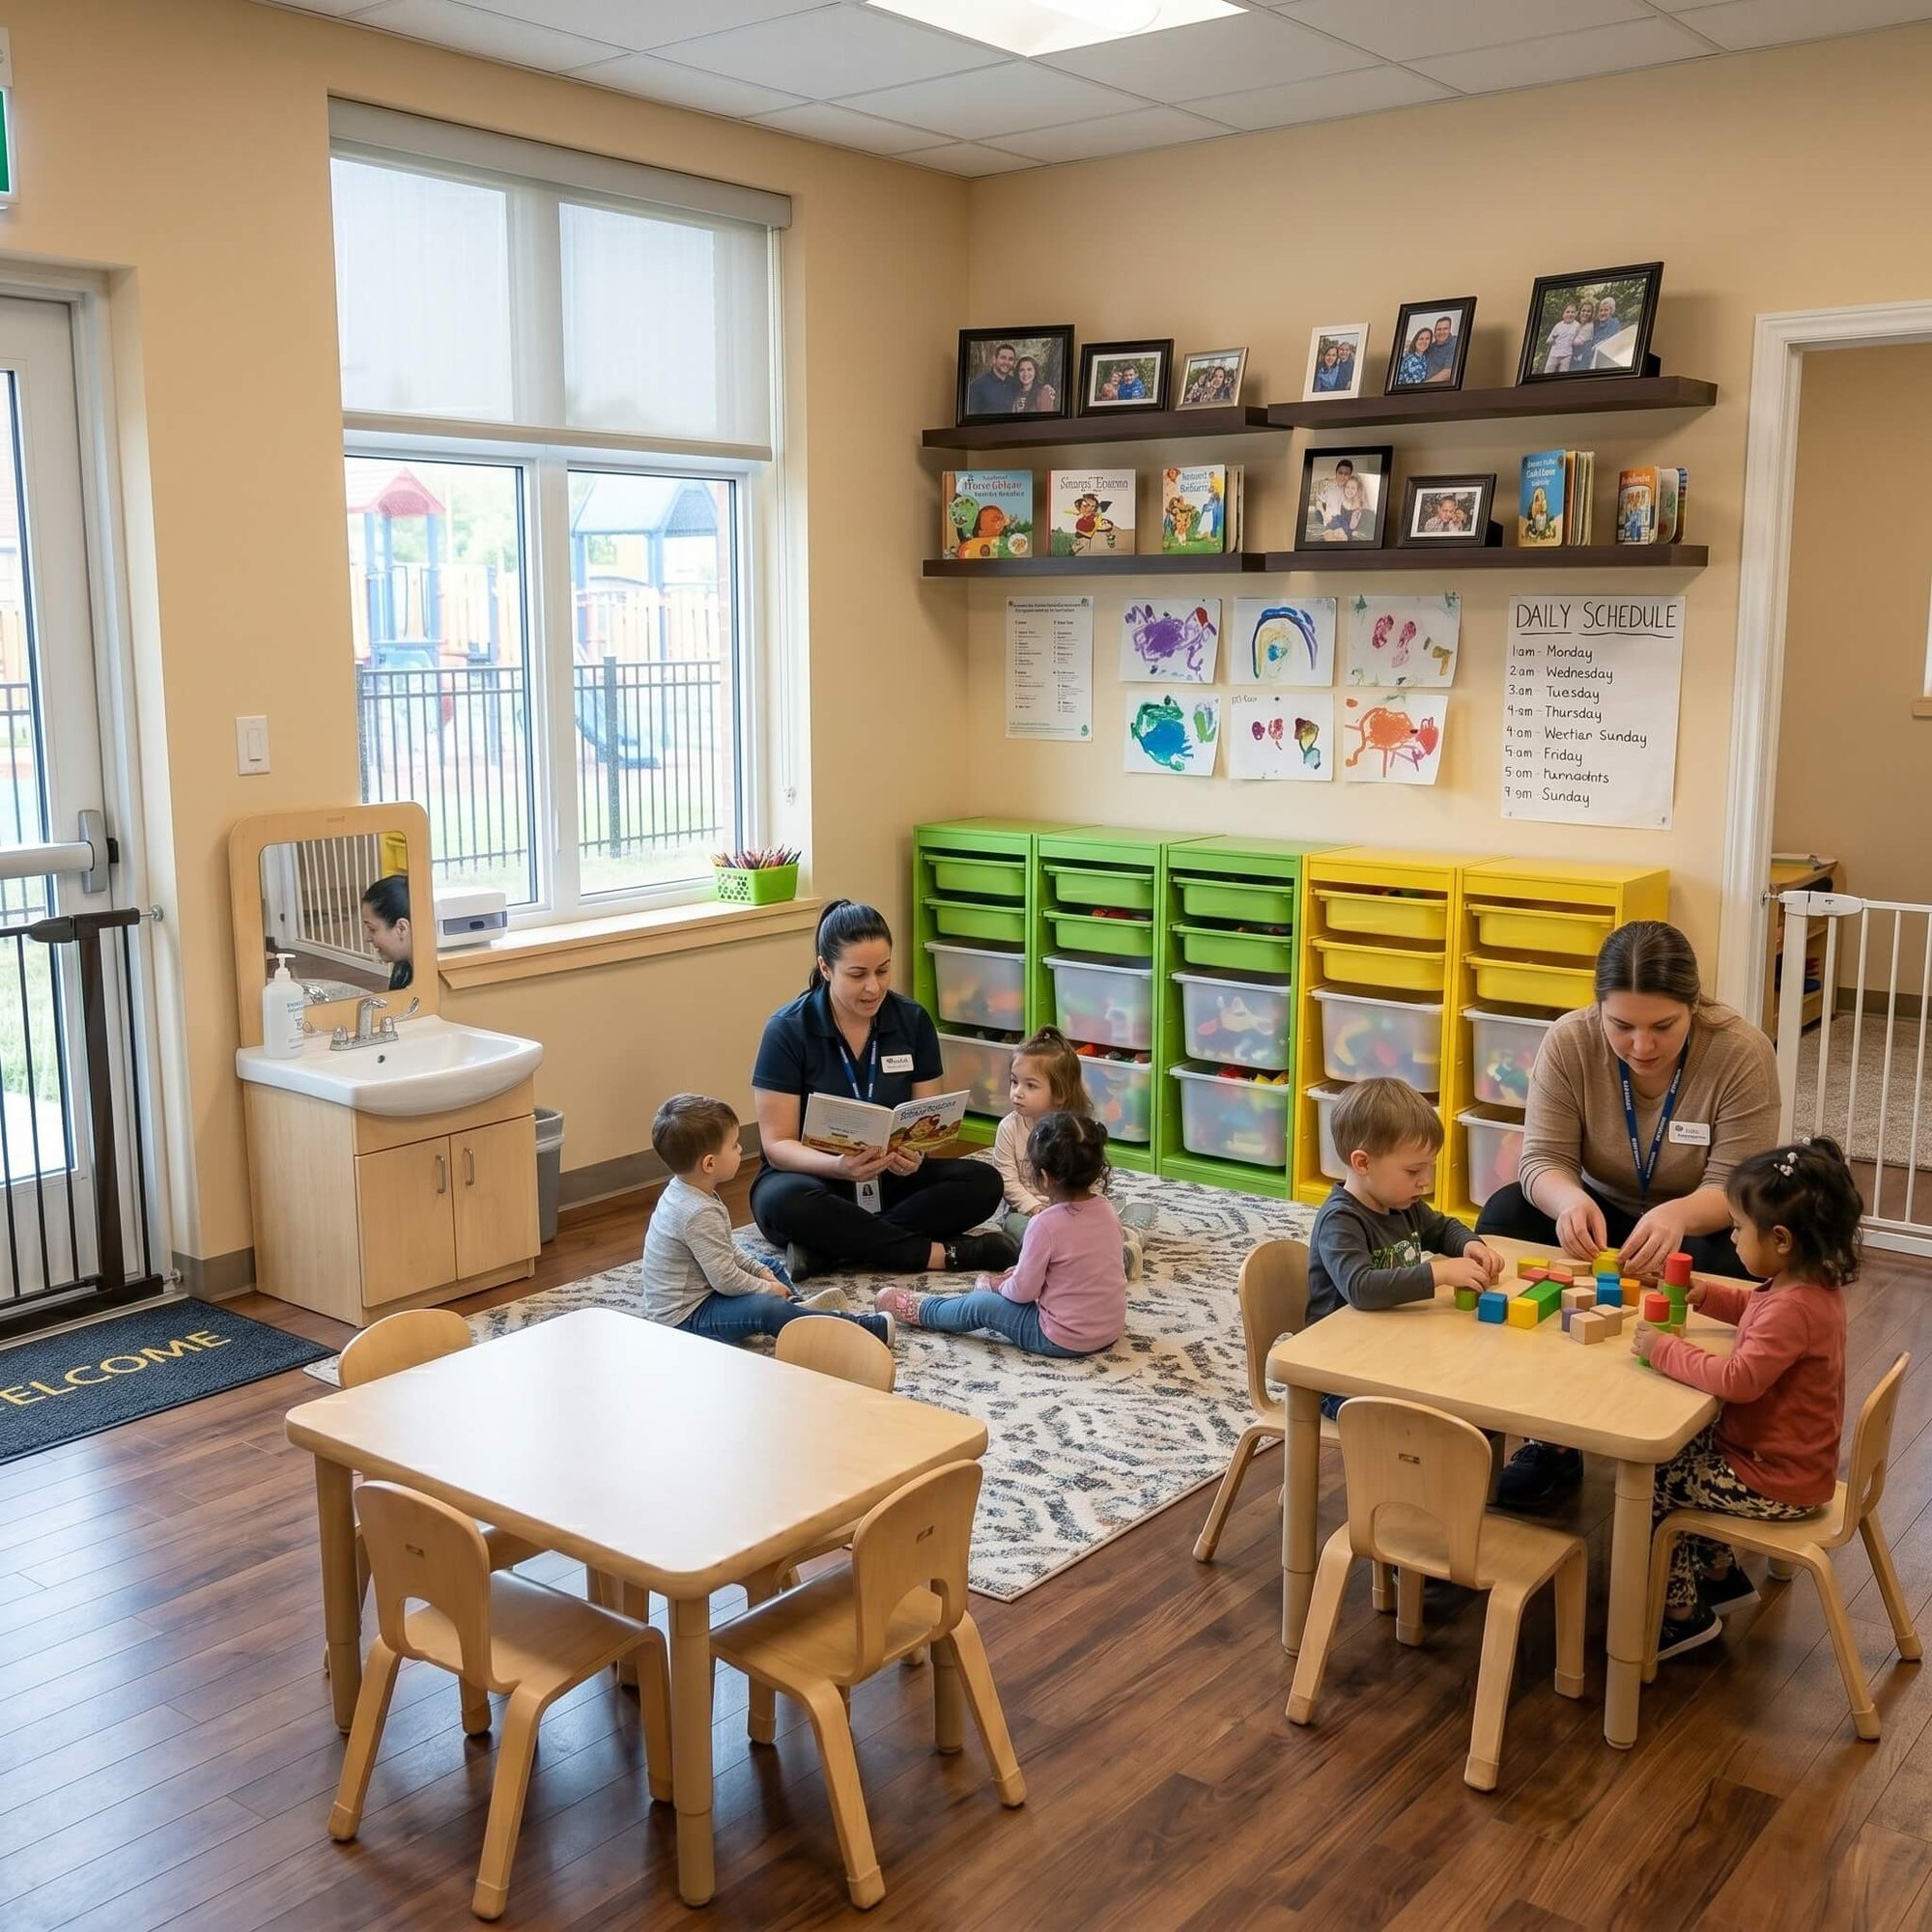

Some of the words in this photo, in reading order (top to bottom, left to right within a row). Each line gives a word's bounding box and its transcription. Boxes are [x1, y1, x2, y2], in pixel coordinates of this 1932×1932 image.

[1516, 604, 1572, 629] DAILY
[1582, 601, 1678, 629] SCHEDULE
[1546, 644, 1593, 664] Monday
[1546, 666, 1613, 685] Wednesday
[1546, 685, 1600, 704] Tuesday
[1546, 705, 1602, 724] Thursday
[1599, 729, 1647, 749] Sunday
[1544, 747, 1582, 767] Friday
[1542, 786, 1591, 808] Sunday
[0, 1330, 232, 1409] ELCOME
